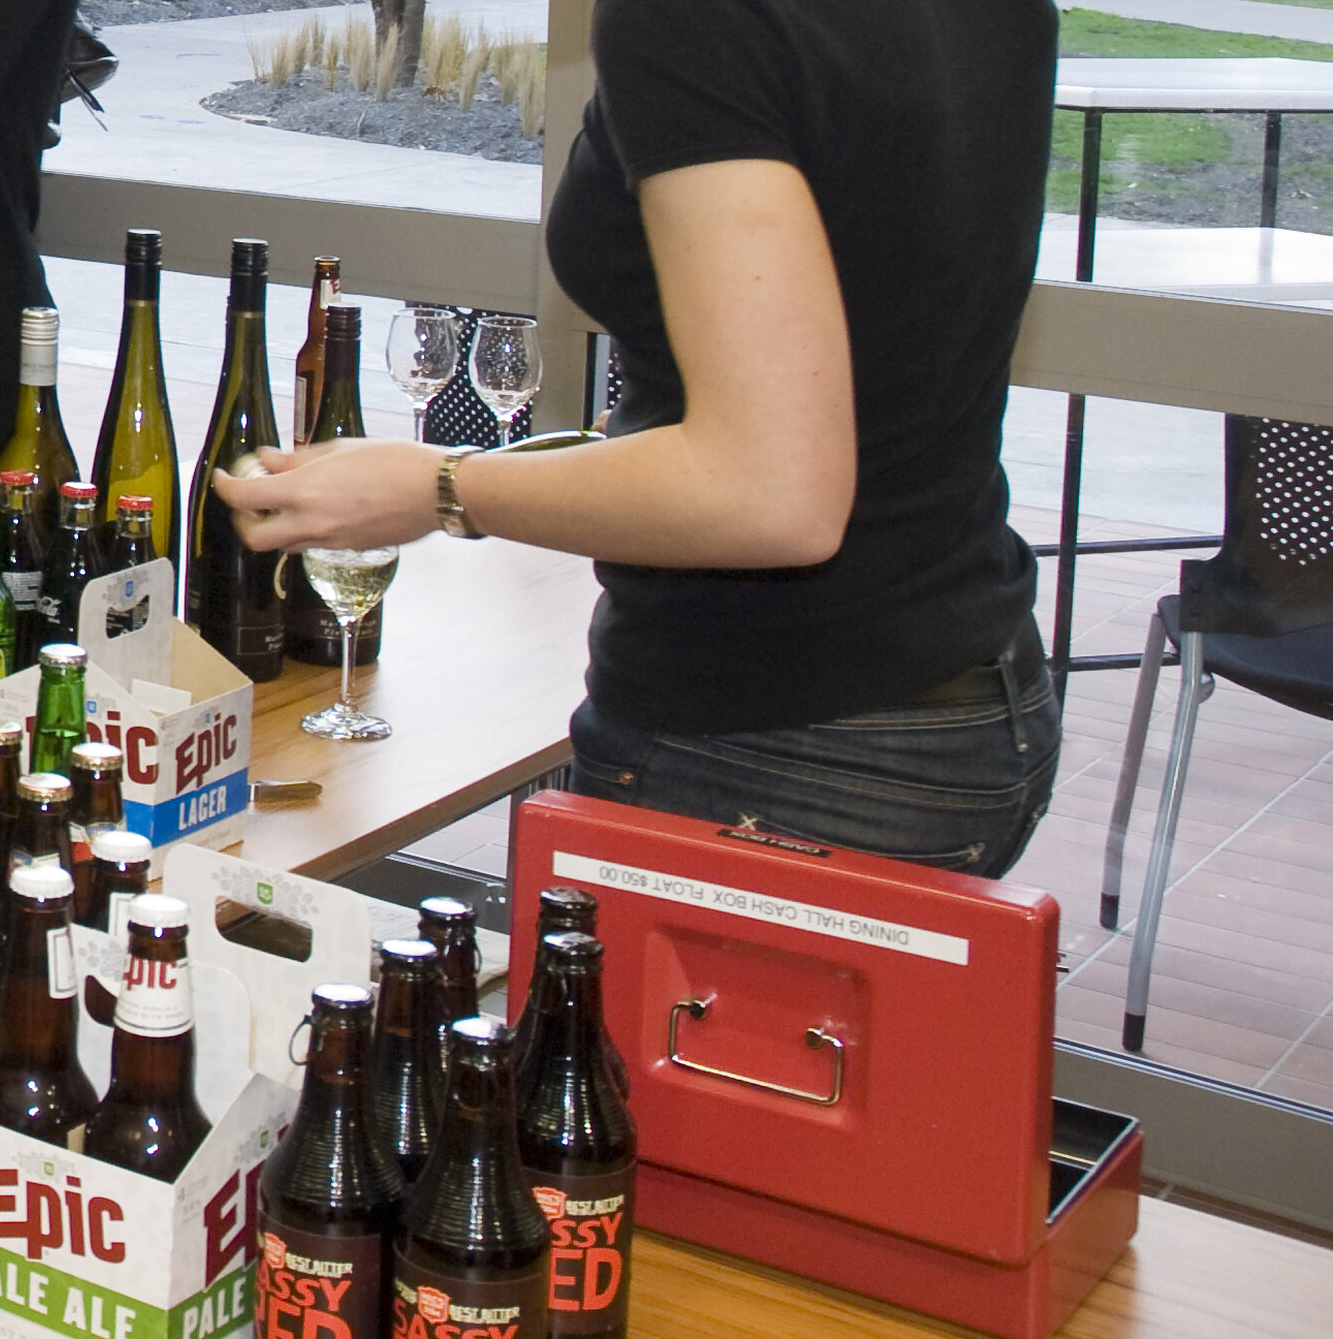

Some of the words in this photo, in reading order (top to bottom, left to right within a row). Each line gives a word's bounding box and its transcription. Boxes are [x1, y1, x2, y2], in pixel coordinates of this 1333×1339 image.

[178, 785, 228, 831] LAGER
[598, 865, 648, 887] $50.00
[652, 878, 705, 900] FLOAT
[712, 890, 747, 909] BOX
[751, 898, 797, 920] CASH
[802, 908, 845, 930] HALL
[848, 919, 910, 945] DINING
[547, 1246, 624, 1312] ED
[63, 1286, 136, 1339] ALE
[183, 1276, 246, 1339] PALE
